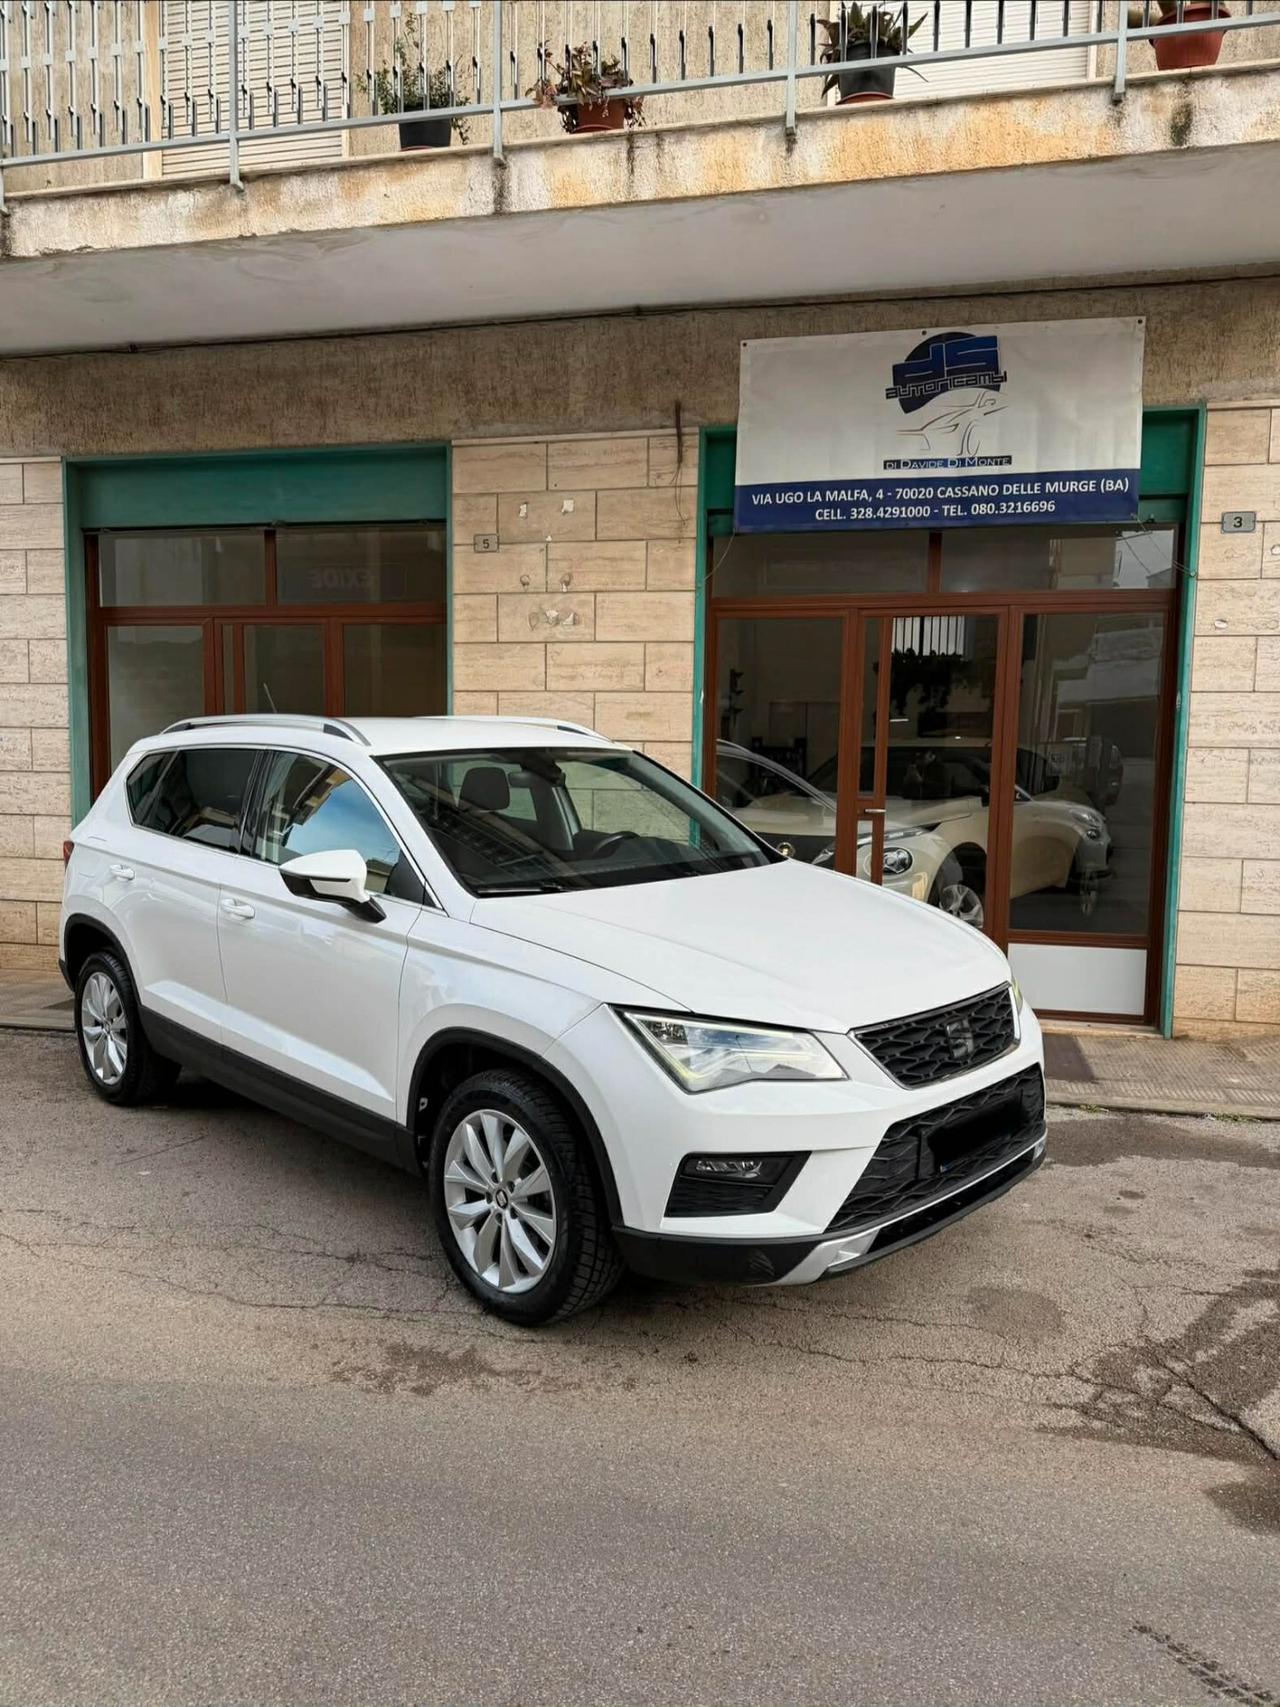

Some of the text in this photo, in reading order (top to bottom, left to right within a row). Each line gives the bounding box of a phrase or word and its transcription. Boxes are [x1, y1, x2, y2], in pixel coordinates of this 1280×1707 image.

[965, 456, 1010, 466] MONTE
[752, 493, 773, 505] VIA
[775, 492, 804, 504] UGO
[807, 490, 822, 502] LA
[825, 489, 873, 502] MALFA,
[875, 488, 884, 499] 4
[895, 487, 934, 499] 70020
[937, 484, 999, 498] CASSANO
[1002, 482, 1042, 495] DELLE
[1045, 480, 1097, 493] MURGE
[1100, 477, 1130, 493] (BA)
[815, 509, 846, 520] CELL.
[849, 506, 931, 519] 328.4291000
[942, 504, 967, 517] TEL.
[971, 500, 1056, 515] 080.3216696
[1233, 516, 1243, 528] 3
[482, 538, 490, 549] 5
